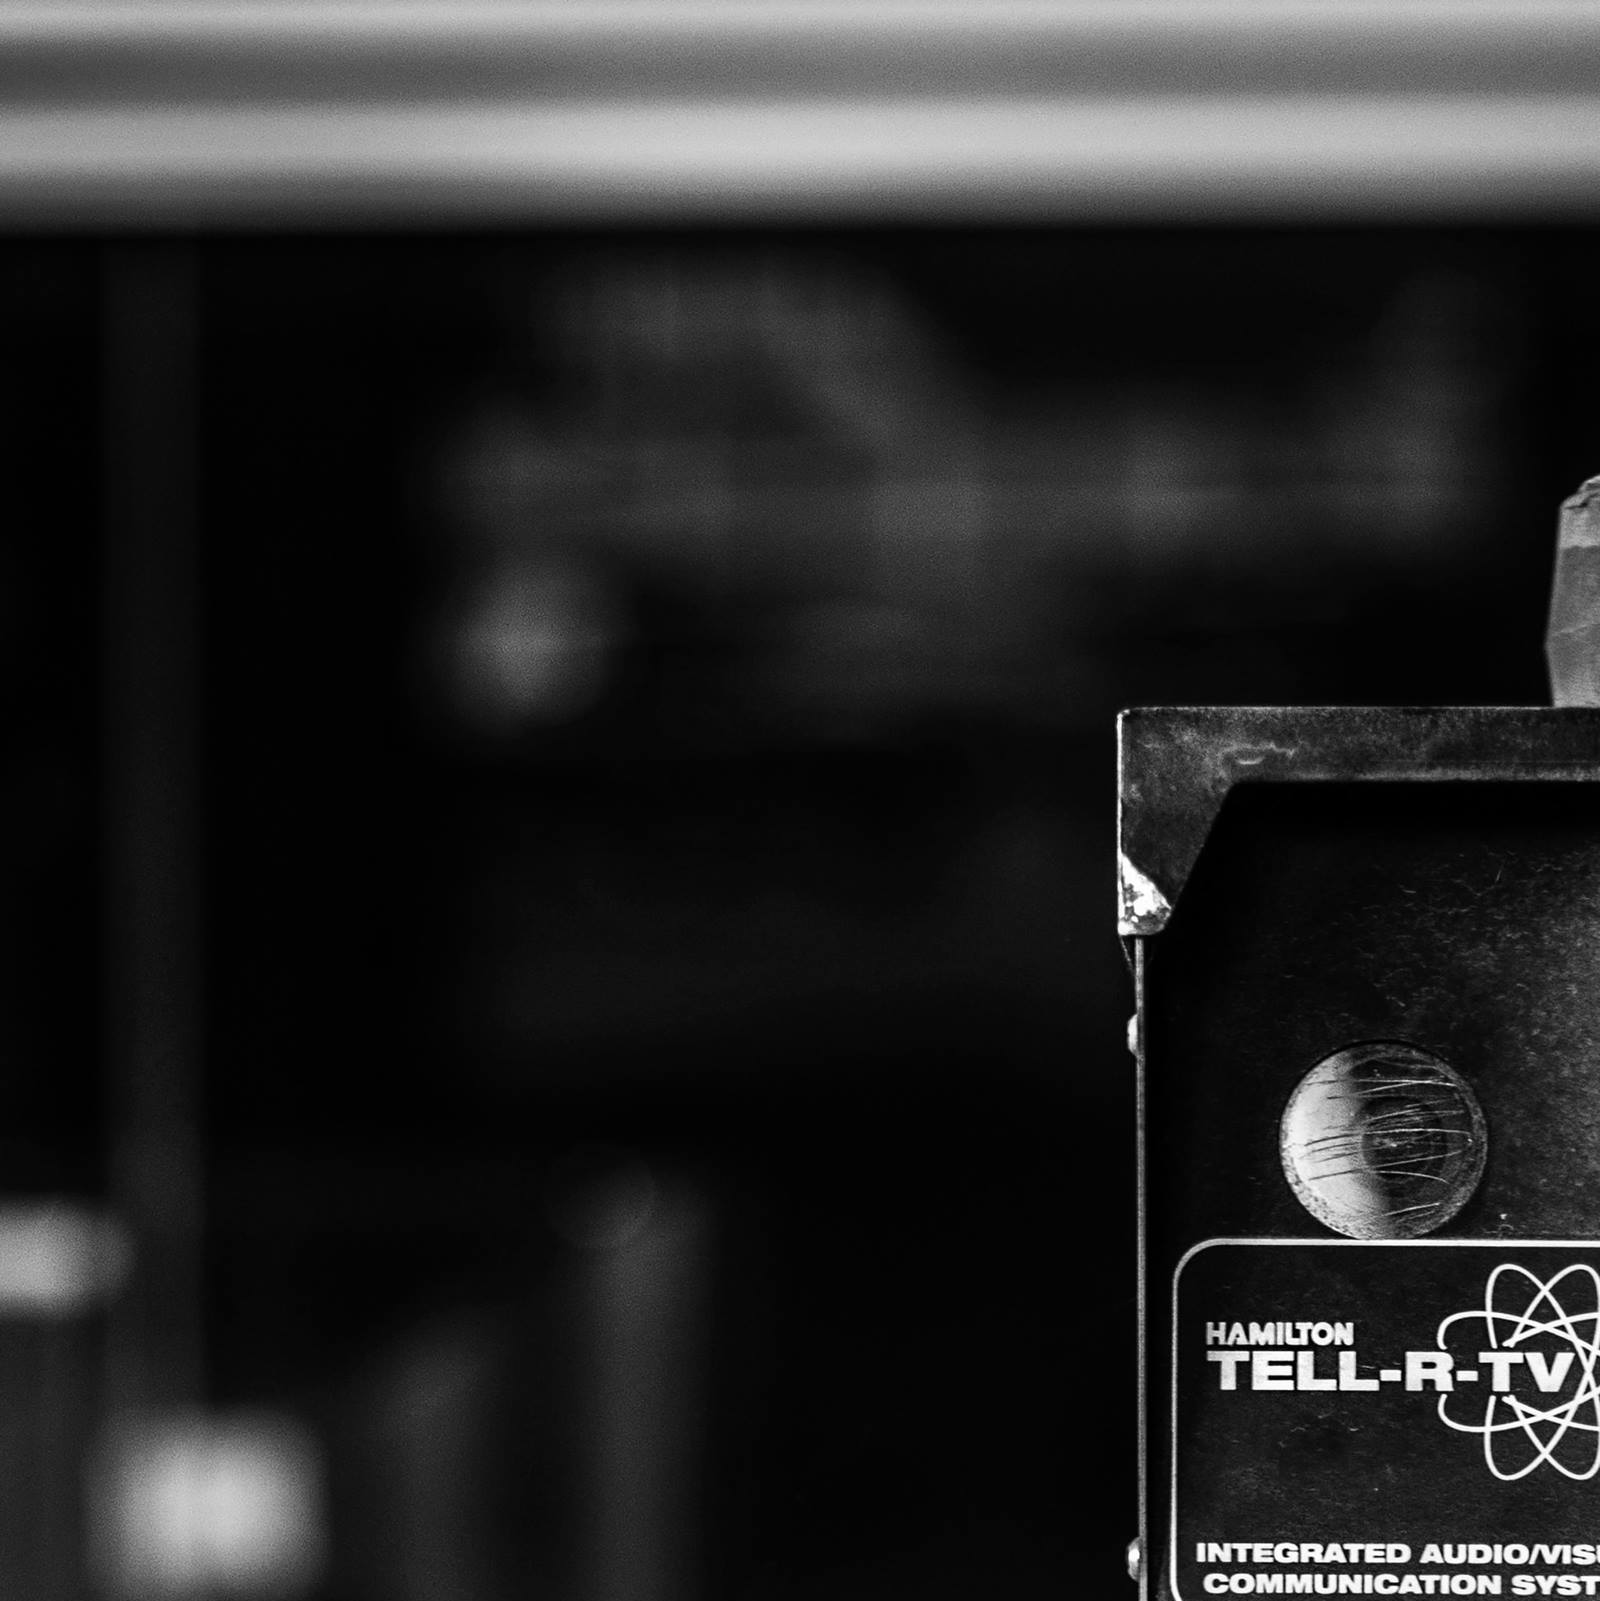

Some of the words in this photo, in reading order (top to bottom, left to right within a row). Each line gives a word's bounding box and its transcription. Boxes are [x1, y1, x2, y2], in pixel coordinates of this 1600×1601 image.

[1206, 1321, 1354, 1347] HAMILTON
[1207, 1350, 1576, 1393] TELL-R-TV
[1196, 1542, 1411, 1565] INTEGRATED
[1202, 1572, 1501, 1596] COMMUNICATION
